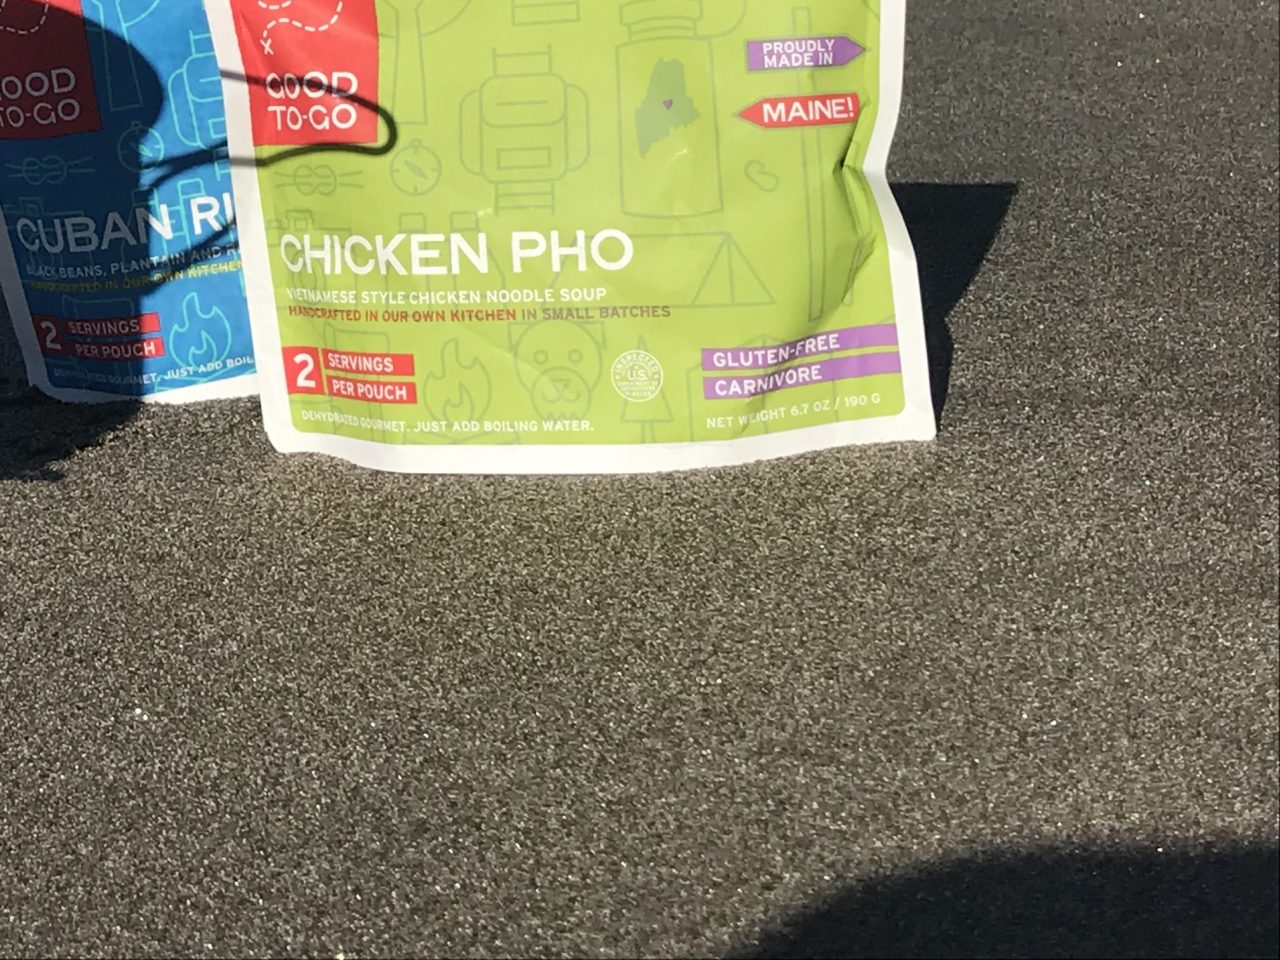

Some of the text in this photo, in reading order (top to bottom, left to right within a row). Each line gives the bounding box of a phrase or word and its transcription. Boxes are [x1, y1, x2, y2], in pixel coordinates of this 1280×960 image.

[763, 39, 835, 54] PROUDLY
[764, 52, 833, 68] MADE IN
[265, 70, 358, 99] GOOD
[267, 103, 357, 130] TO-GO
[763, 97, 854, 123] MAINE!
[16, 203, 173, 255] CUBAN
[58, 263, 107, 279] BEANS,
[111, 253, 186, 275] PLANTAIN
[190, 245, 221, 261] AND
[280, 228, 634, 275] CHICKEN PHO
[286, 287, 607, 305] VIETNAMESE STYLE CHICKEN NOODLE SOUP
[288, 305, 671, 322] HANDCRAFTED IN OUR OWN KITCHEN IN SMALL BATCHES
[40, 320, 62, 350] 2
[67, 319, 140, 335] SERVINGS
[75, 341, 156, 358] PER POUCH
[327, 353, 394, 372] SERVINGS
[713, 333, 840, 368] GLUTEN-FREE
[164, 367, 194, 379] JUST
[198, 360, 223, 374] ADD
[293, 352, 316, 388] 2
[715, 366, 822, 396] CARNIVORE
[332, 379, 407, 401] PER POUCH
[301, 409, 358, 426] DEHYDRATED
[414, 420, 446, 432] JUST
[452, 421, 479, 432] ADD
[484, 420, 538, 432] BOILING
[542, 420, 594, 432] WATER.
[706, 416, 734, 429] NET
[738, 407, 786, 426] WEIGHT
[790, 403, 809, 417] 6.7
[813, 400, 830, 412] OZ
[844, 394, 867, 407] 190
[871, 393, 881, 403] G
